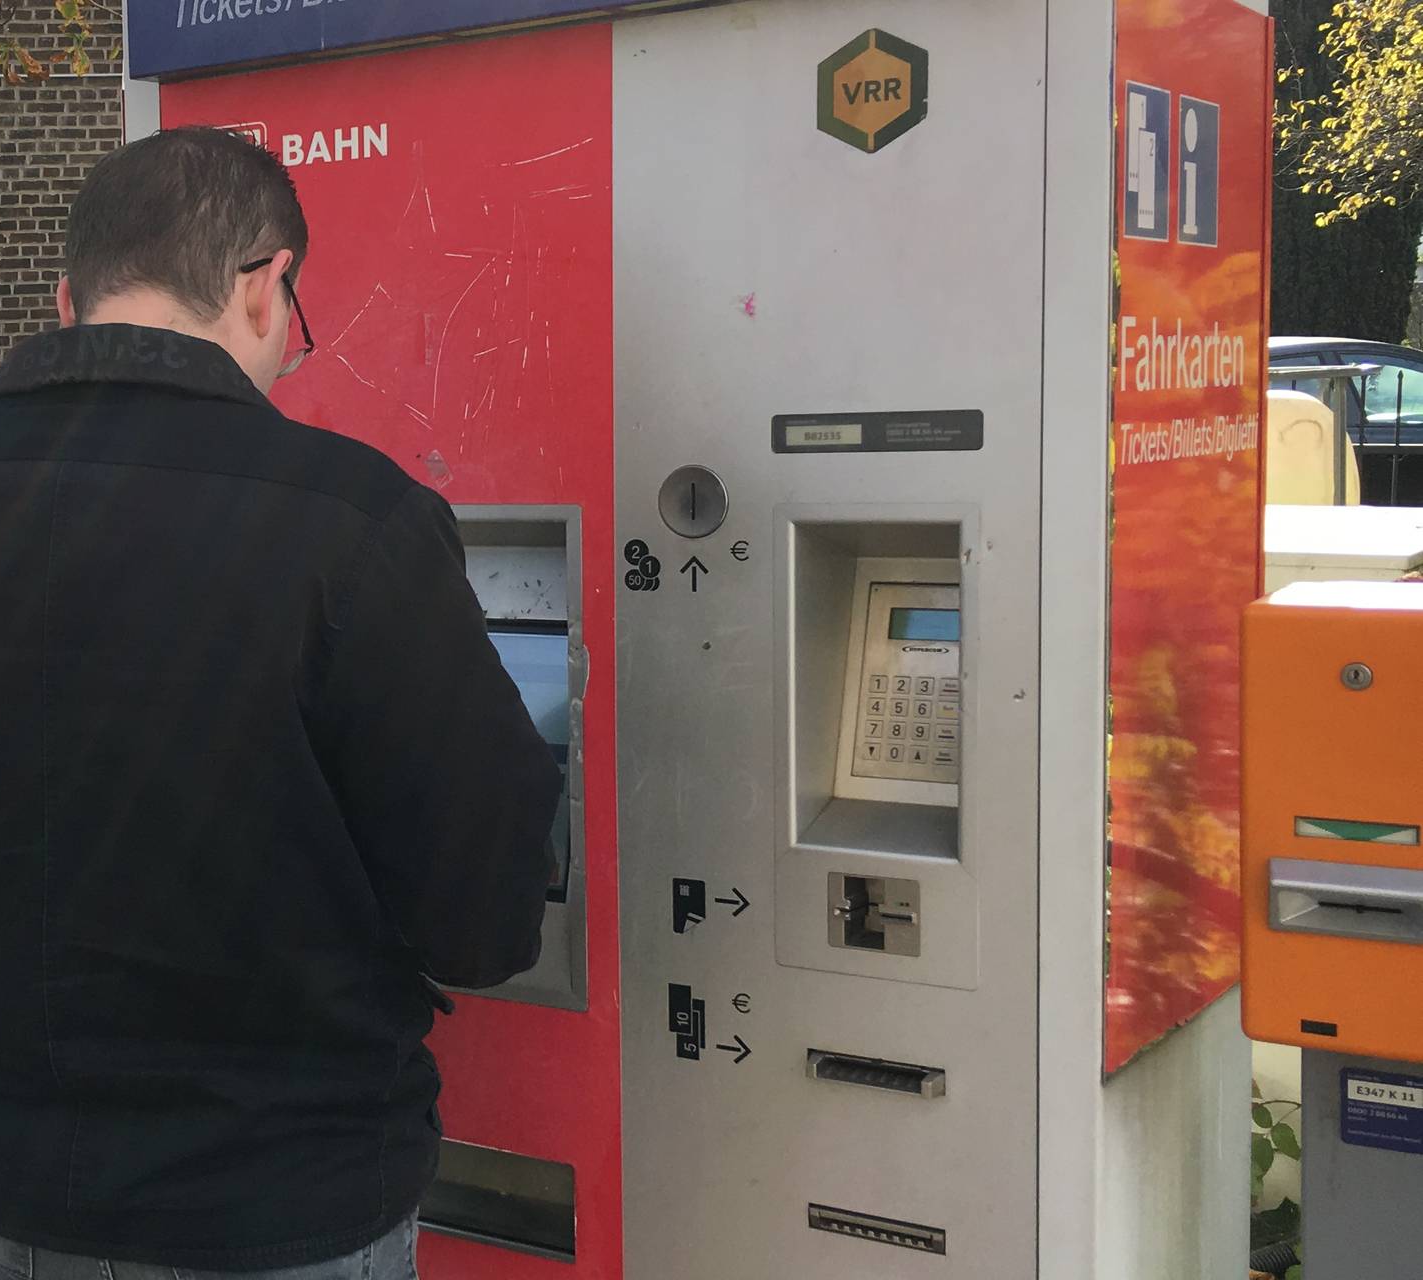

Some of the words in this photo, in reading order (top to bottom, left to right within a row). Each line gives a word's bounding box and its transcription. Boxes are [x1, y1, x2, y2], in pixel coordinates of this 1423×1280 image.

[177, 0, 346, 27] Tickets
[842, 78, 901, 105] VRR
[282, 123, 388, 167] BAHN
[1121, 316, 1244, 391] Fahrkarten
[1120, 412, 1259, 465] Tickets/Billets/Biglietti
[631, 545, 641, 559] 2
[730, 540, 750, 561] €
[645, 560, 653, 574] 1
[628, 575, 642, 586] 50
[875, 679, 881, 690] 1
[897, 680, 906, 691] 2
[920, 681, 929, 692] 3
[871, 701, 880, 712] 4
[895, 702, 903, 713] 5
[918, 703, 927, 715] 6
[870, 723, 878, 735] 7
[892, 724, 901, 736] 8
[915, 726, 924, 738] 9
[890, 747, 899, 759] 0
[732, 993, 751, 1014] €
[677, 1012, 689, 1026] 10
[684, 1043, 697, 1053] 5
[1357, 1086, 1385, 1098] E347
[1389, 1091, 1397, 1099] K
[1401, 1092, 1415, 1102] 11
